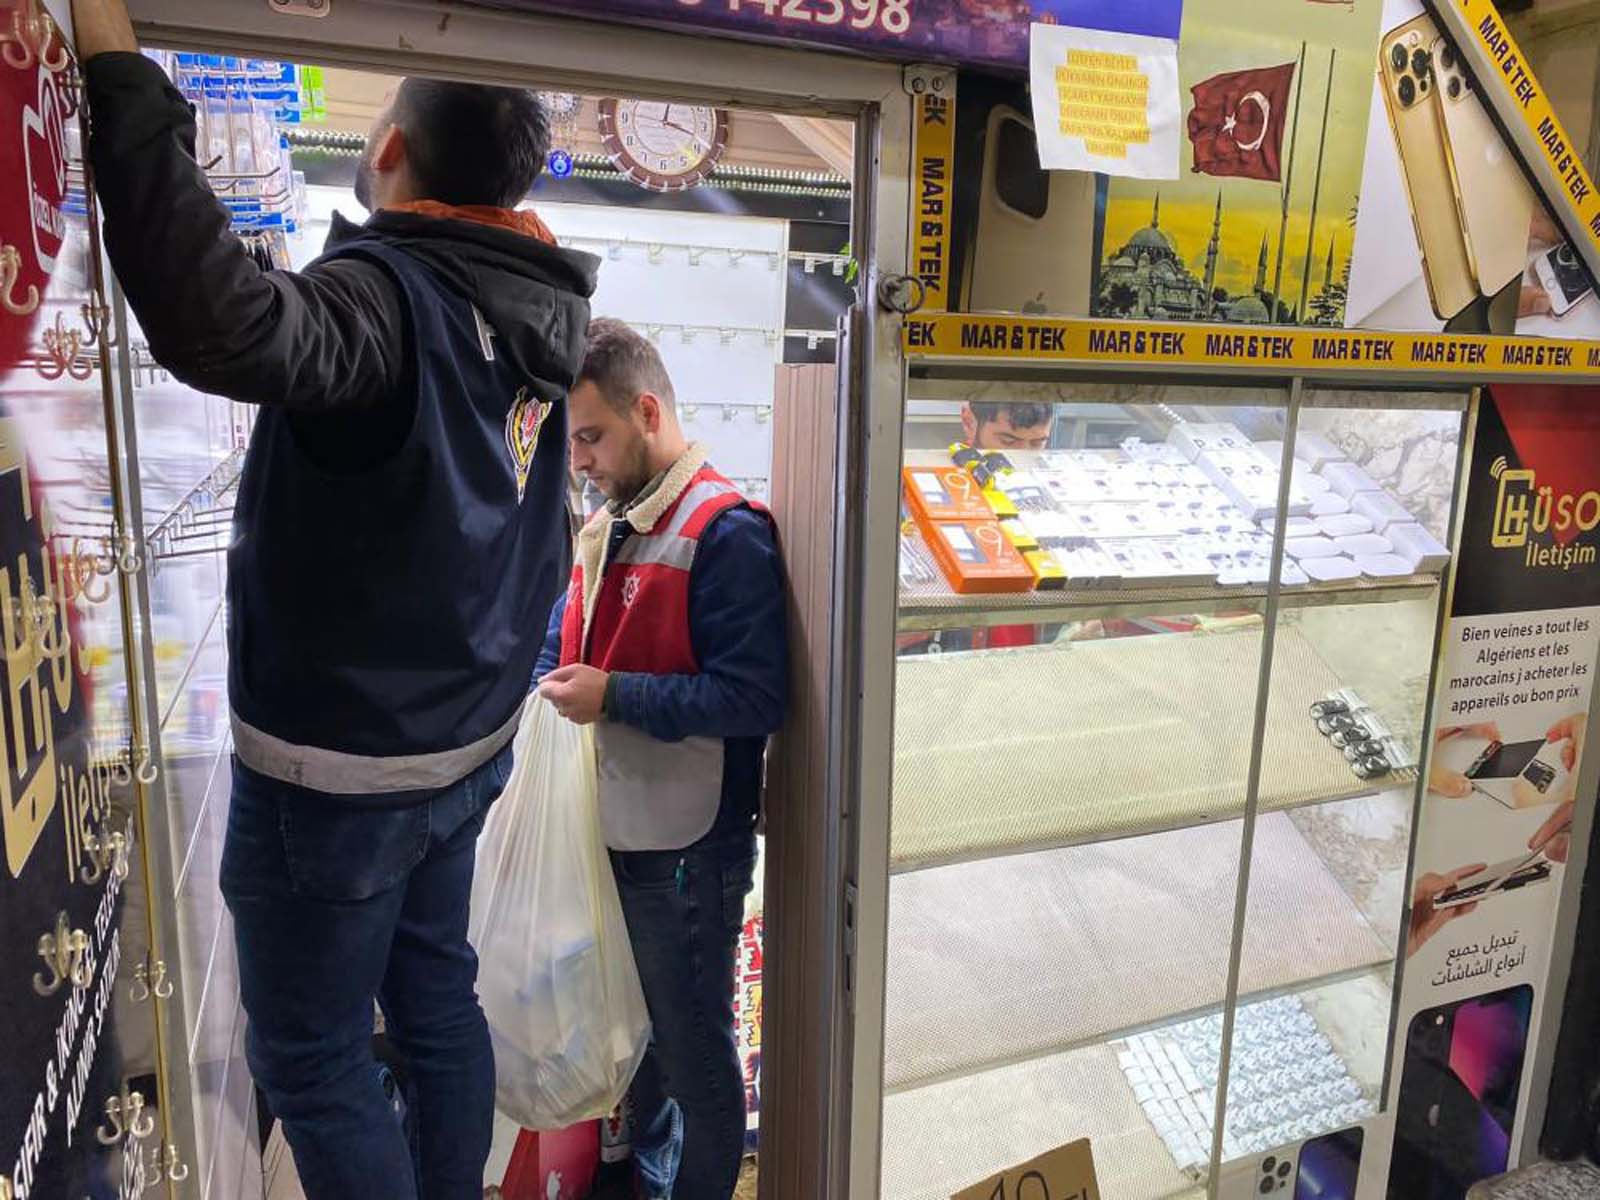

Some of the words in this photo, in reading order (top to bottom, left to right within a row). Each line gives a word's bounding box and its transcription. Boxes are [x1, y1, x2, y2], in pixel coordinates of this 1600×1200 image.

[727, 0, 912, 34] 2598
[903, 321, 937, 346] EK
[1586, 347, 1600, 367] M
[1503, 486, 1600, 533] HÜSO
[1462, 626, 1490, 642] Bien
[1493, 622, 1532, 639] veines
[1535, 624, 1542, 634] a
[1545, 620, 1570, 634] tout
[1573, 617, 1590, 632] les
[1476, 645, 1536, 666] Algériens
[1538, 644, 1550, 657] et
[1552, 642, 1569, 656] les
[1450, 670, 1515, 690] marocains
[1524, 665, 1568, 681] acheter
[1571, 662, 1588, 676] les
[1451, 692, 1510, 714] appareils
[1513, 693, 1528, 705] ou
[1530, 688, 1555, 702] bon
[1556, 684, 1581, 703] prix
[1482, 930, 1519, 954] تبديل
[1431, 958, 1492, 987] الشاشات
[46, 1060, 58, 1112] &
